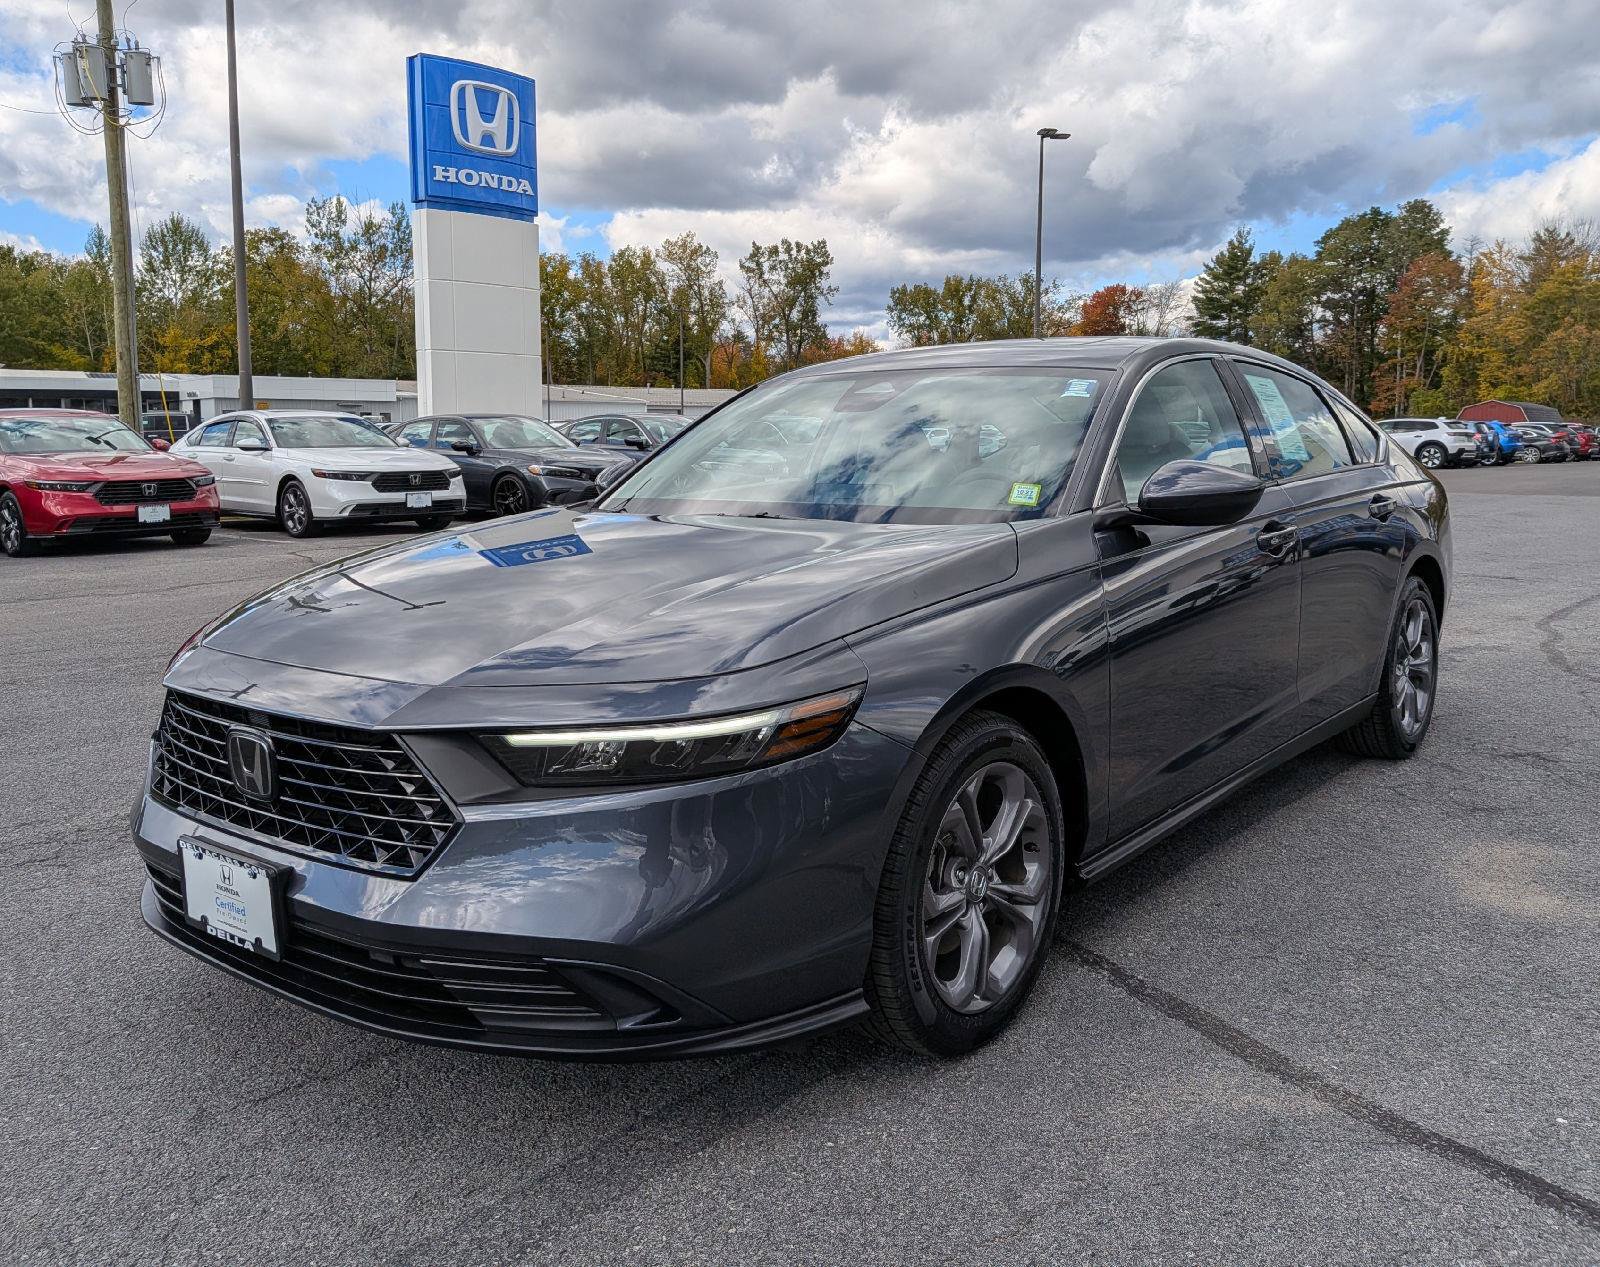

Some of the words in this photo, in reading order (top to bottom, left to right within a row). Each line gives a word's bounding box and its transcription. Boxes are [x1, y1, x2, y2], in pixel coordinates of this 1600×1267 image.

[433, 165, 535, 196] HONDA
[216, 883, 241, 898] HONDA
[215, 897, 246, 917] Certified
[207, 925, 255, 952] DELLA
[907, 905, 922, 992] GENERAL
